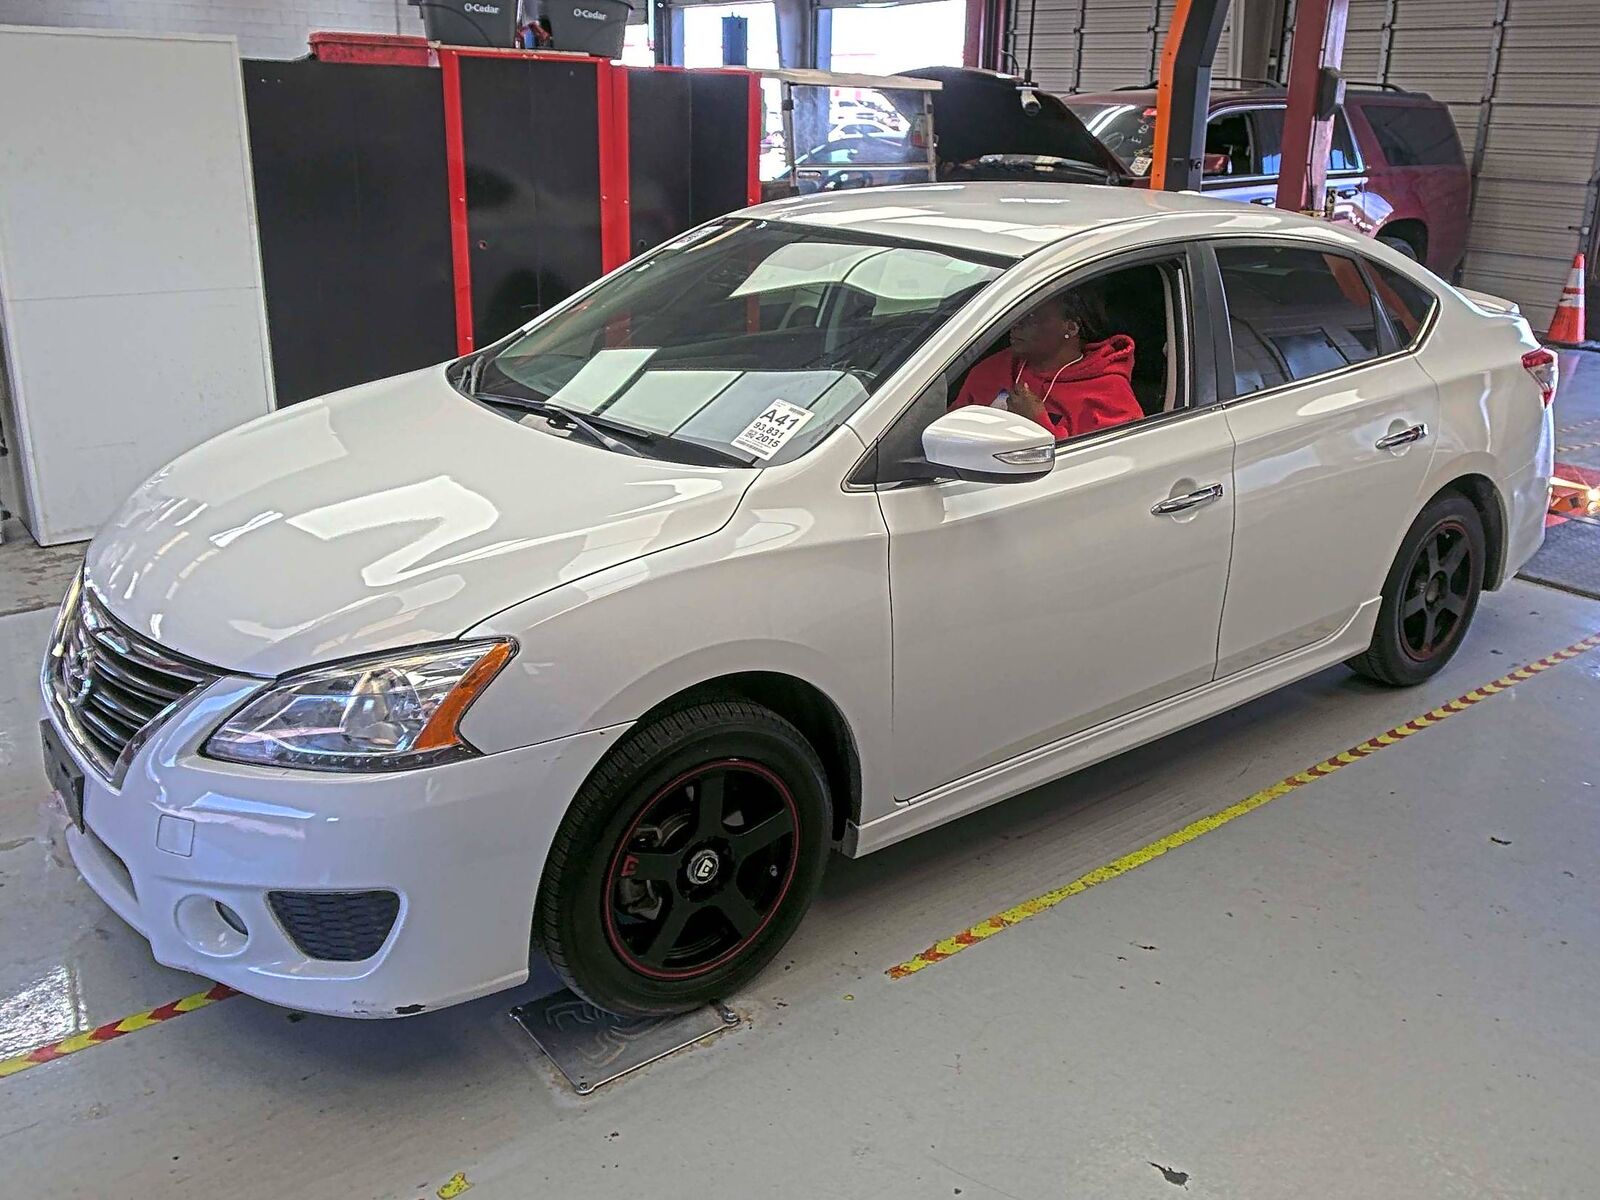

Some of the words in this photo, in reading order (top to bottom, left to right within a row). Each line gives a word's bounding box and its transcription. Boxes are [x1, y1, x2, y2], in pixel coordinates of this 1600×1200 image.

[759, 409, 800, 430] A41
[753, 421, 785, 438] 93,831
[755, 433, 781, 448] 2015
